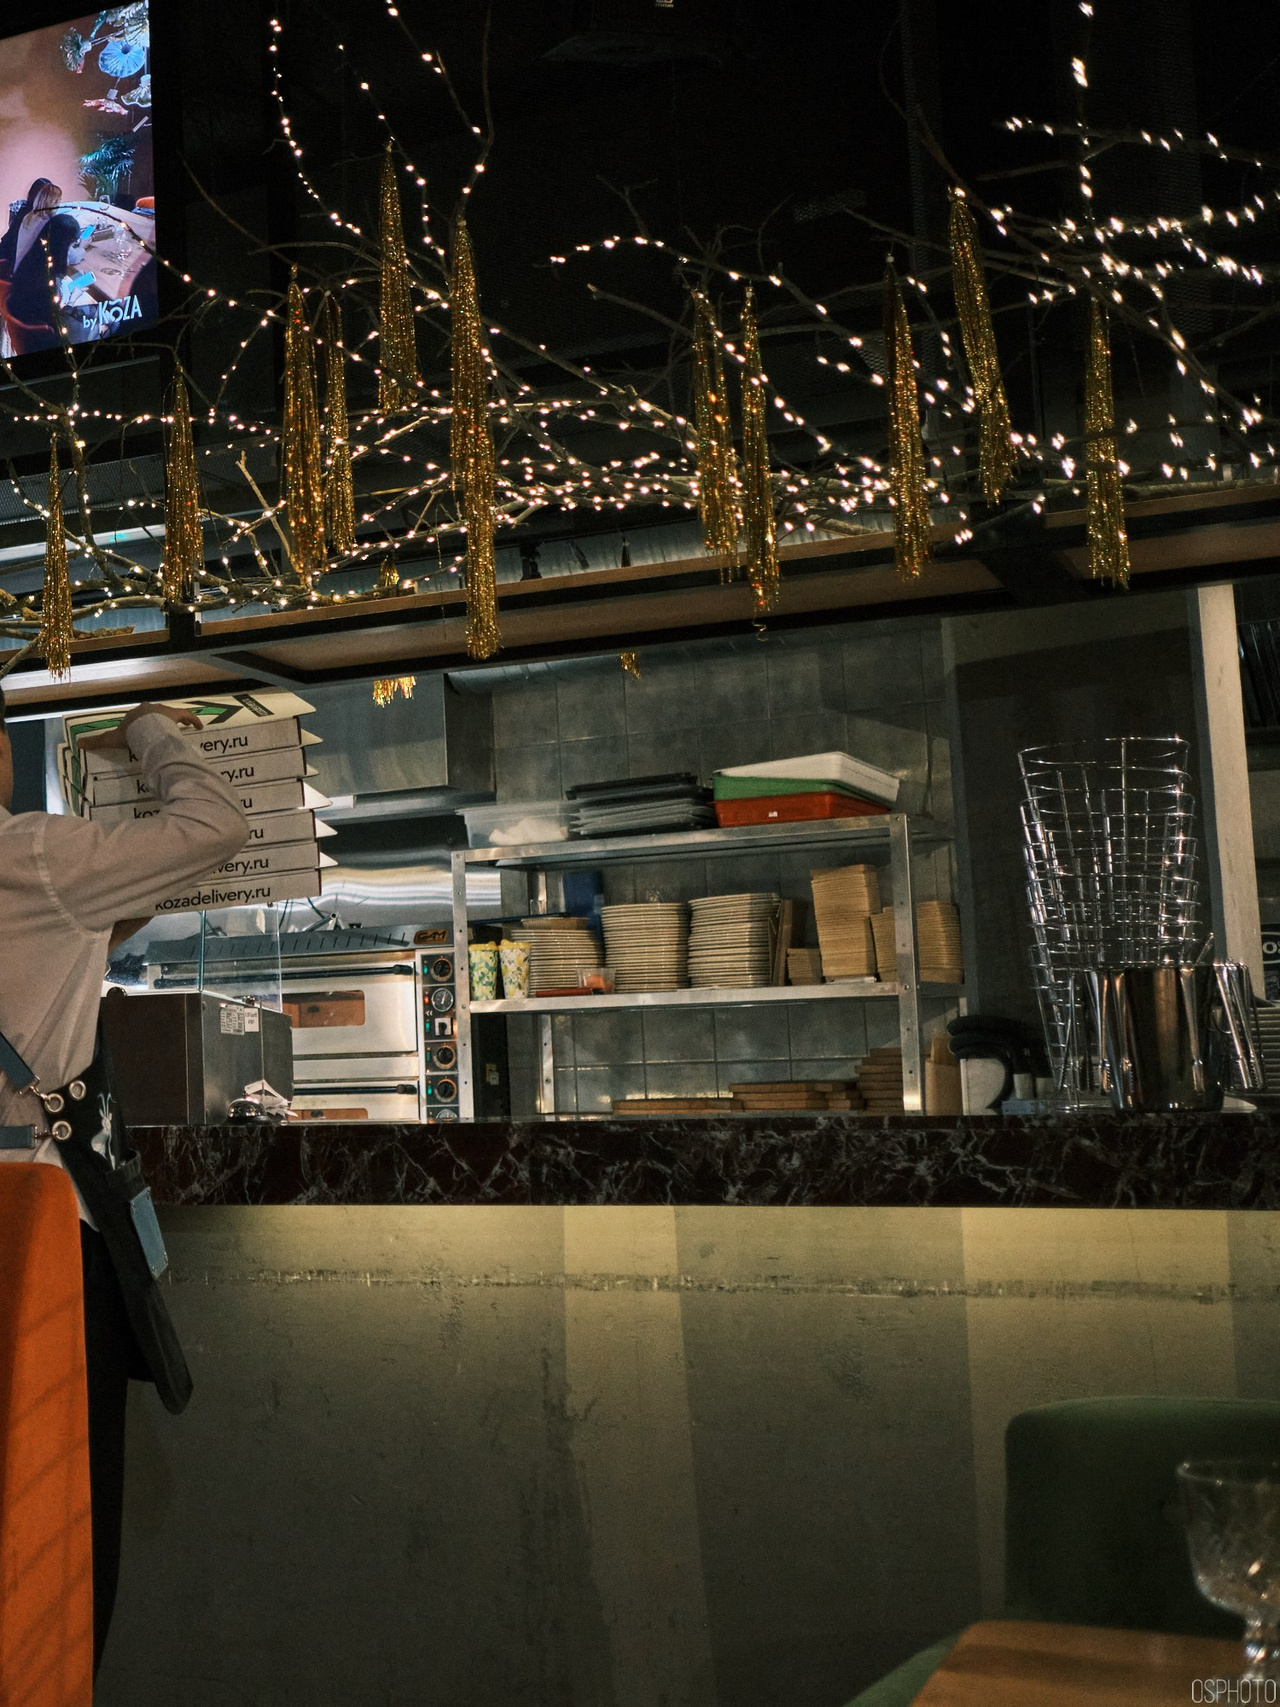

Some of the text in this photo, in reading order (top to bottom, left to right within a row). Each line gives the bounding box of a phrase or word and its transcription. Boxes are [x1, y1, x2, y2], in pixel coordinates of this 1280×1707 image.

[83, 315, 98, 331] by
[200, 735, 248, 754] ery.ru
[212, 857, 269, 875] very.ru
[154, 886, 271, 911] kozadelivery.ru
